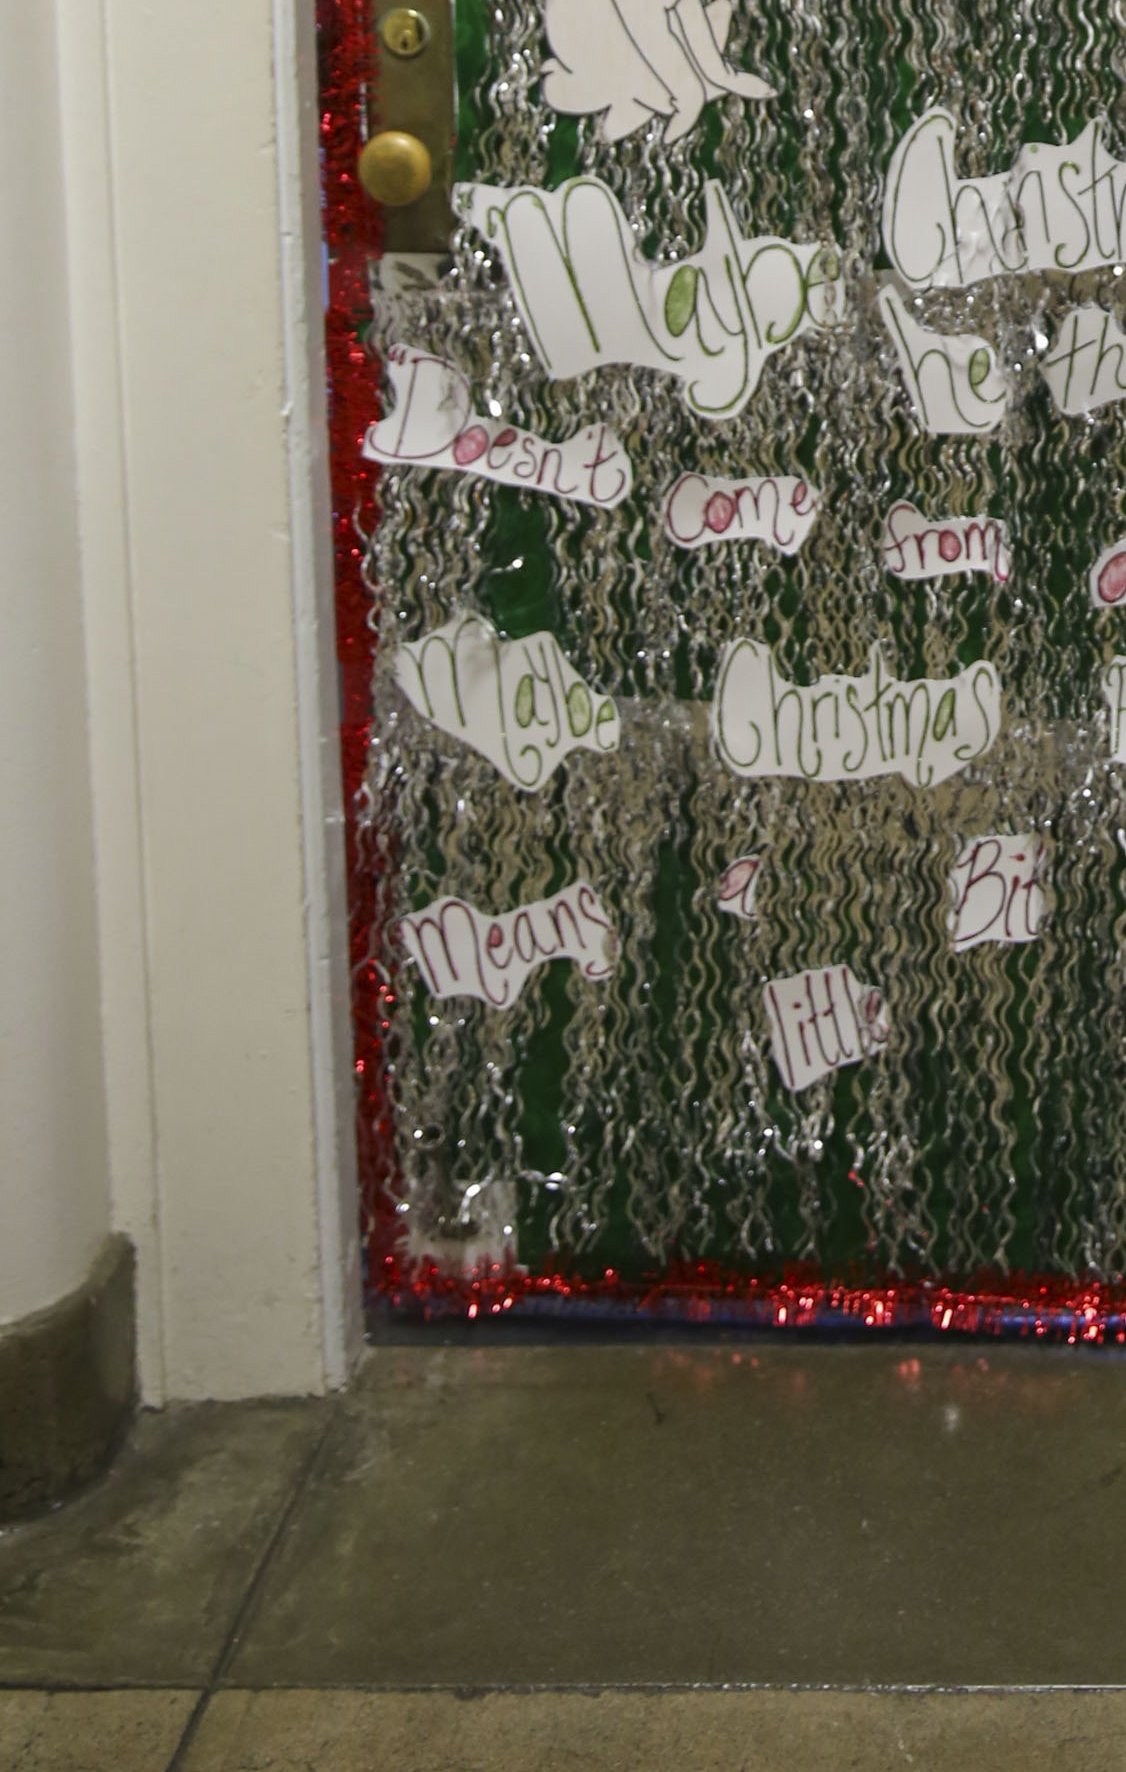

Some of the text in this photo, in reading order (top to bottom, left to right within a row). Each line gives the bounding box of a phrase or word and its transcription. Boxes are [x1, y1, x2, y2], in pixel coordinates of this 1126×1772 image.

[886, 296, 1006, 428] he
[885, 502, 1009, 582] from
[401, 618, 617, 787] Maybe
[718, 638, 993, 789] Christmas
